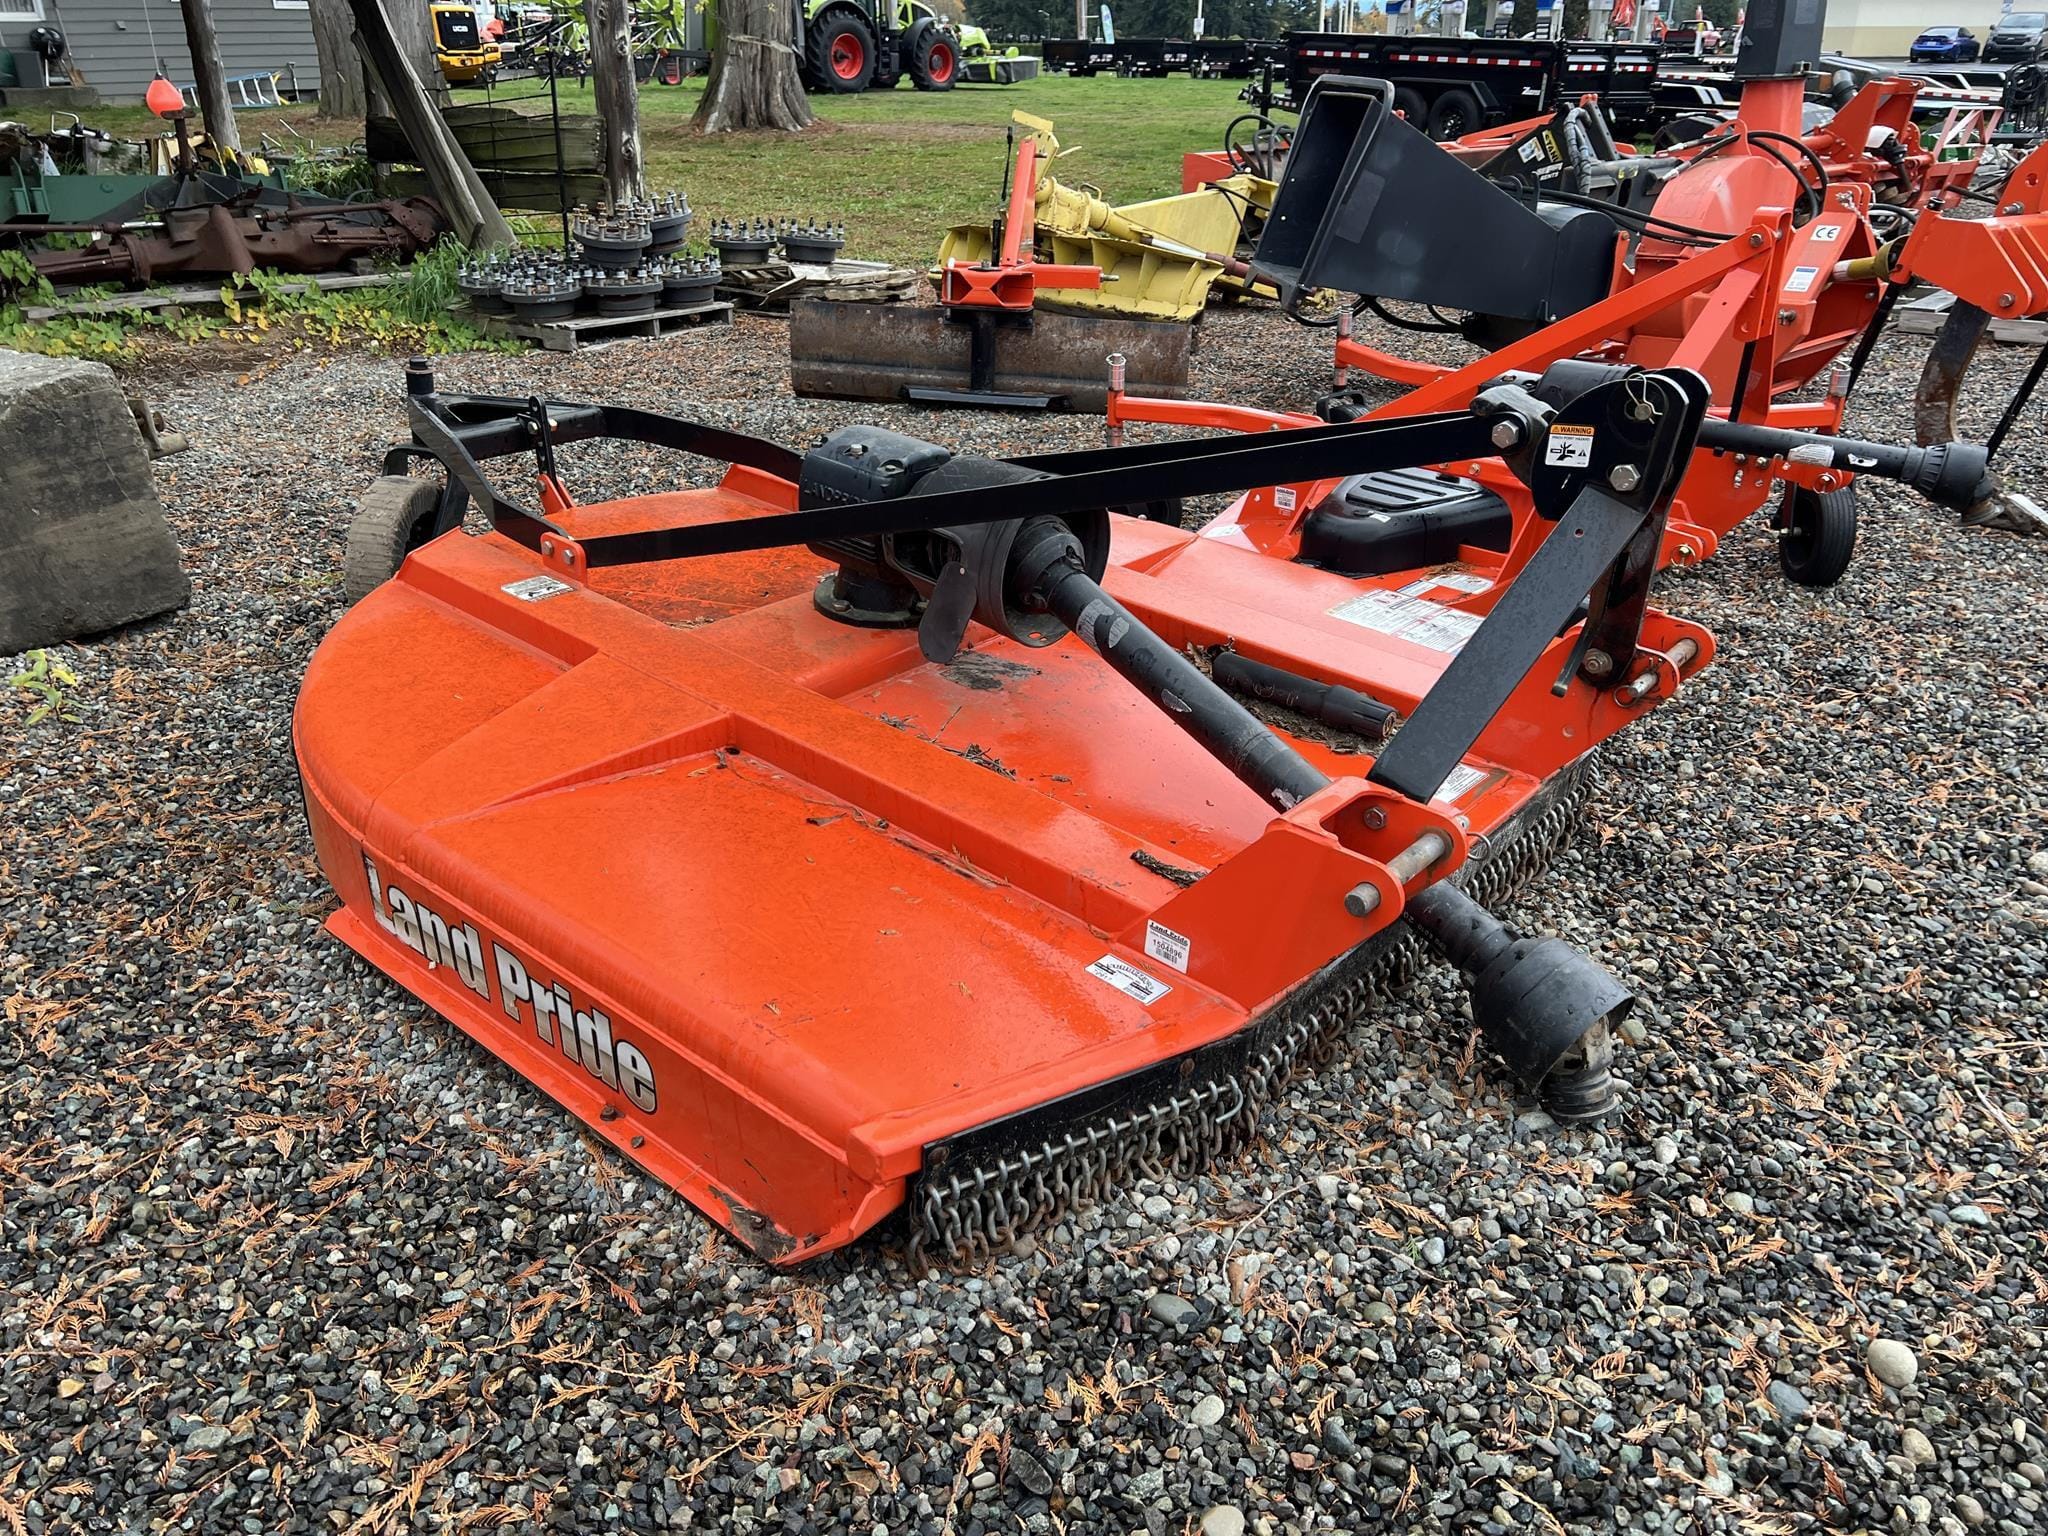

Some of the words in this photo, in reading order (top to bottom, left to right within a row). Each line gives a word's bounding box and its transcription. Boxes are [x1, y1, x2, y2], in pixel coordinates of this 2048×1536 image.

[452, 25, 468, 33] JCB
[1815, 227, 1838, 239] CE
[1560, 426, 1592, 435] WARNING
[362, 854, 490, 1002] Land
[493, 942, 657, 1114] Pride
